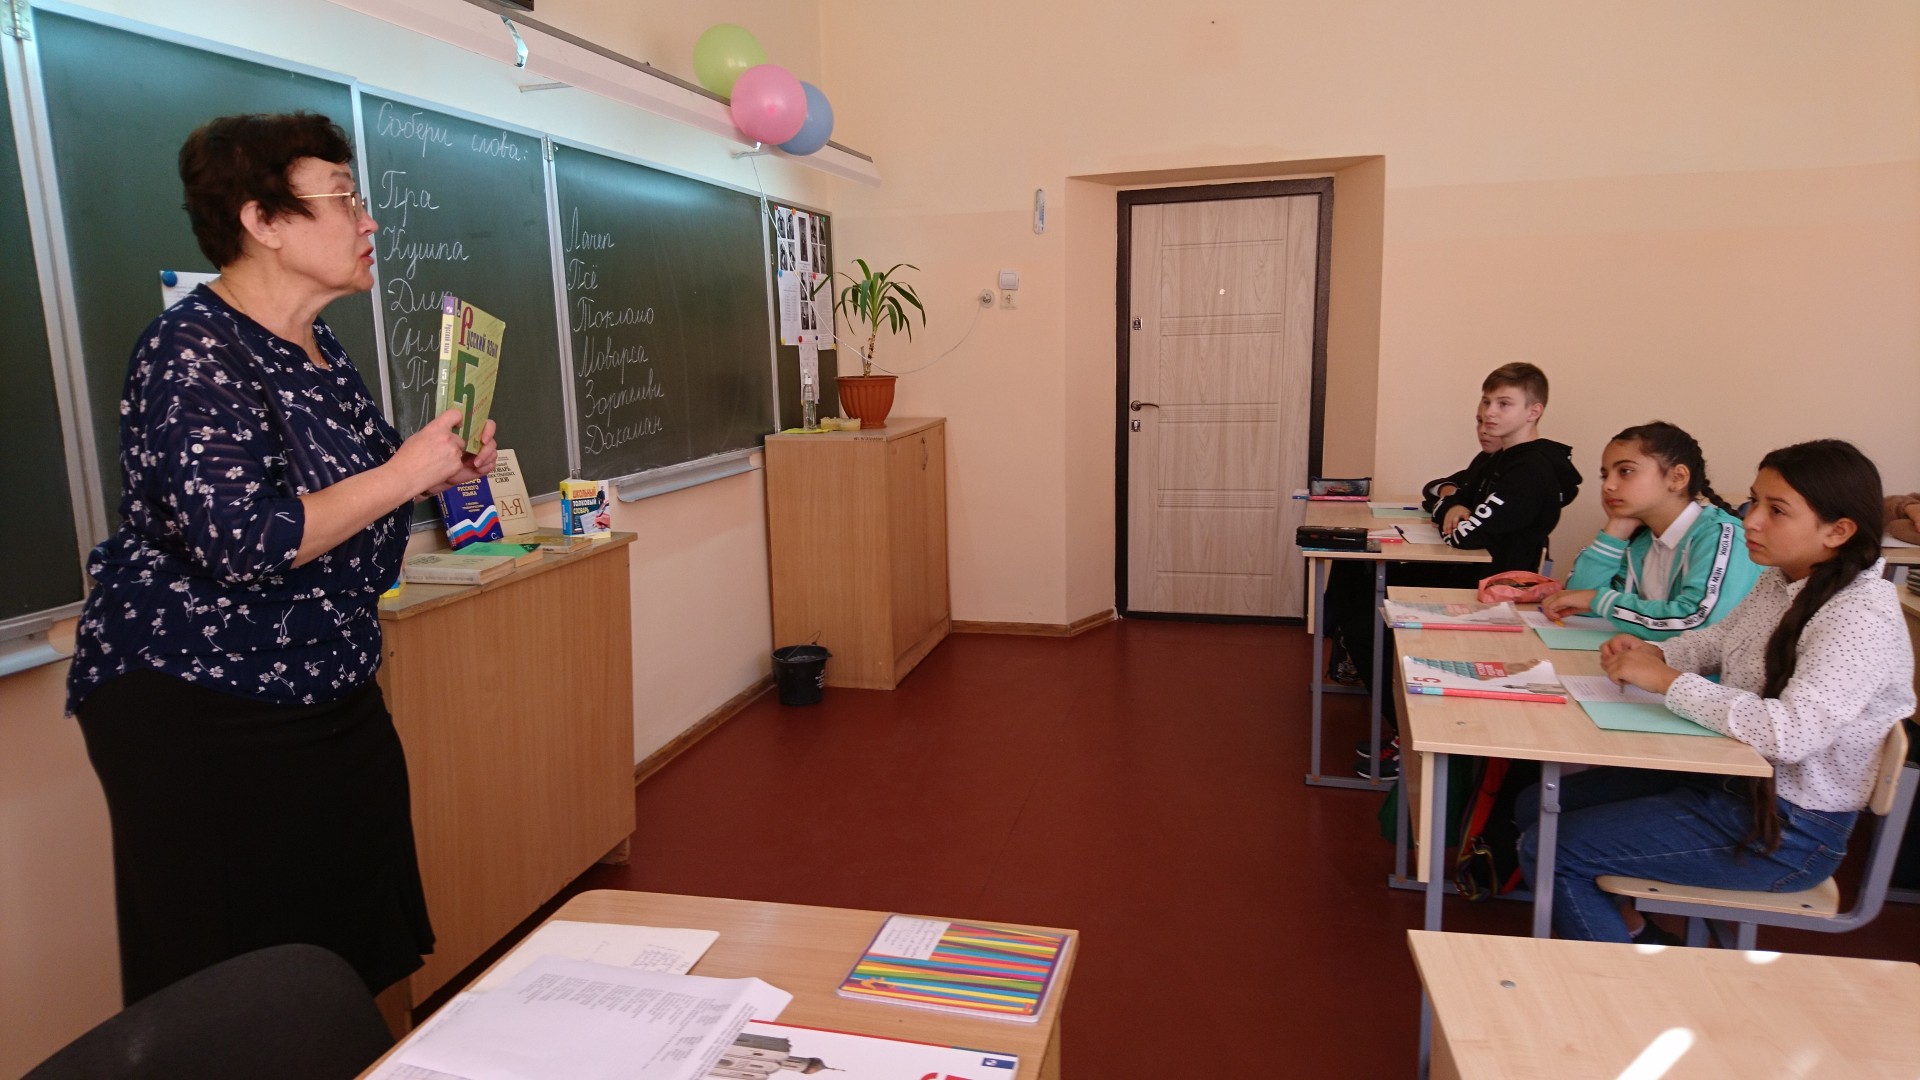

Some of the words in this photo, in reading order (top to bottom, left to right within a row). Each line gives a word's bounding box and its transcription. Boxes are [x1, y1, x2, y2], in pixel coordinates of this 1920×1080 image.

[377, 101, 453, 158] Собери
[471, 131, 529, 161] слова:
[379, 170, 440, 227] Пра
[567, 258, 598, 291] Псё
[500, 497, 525, 518] А-Я
